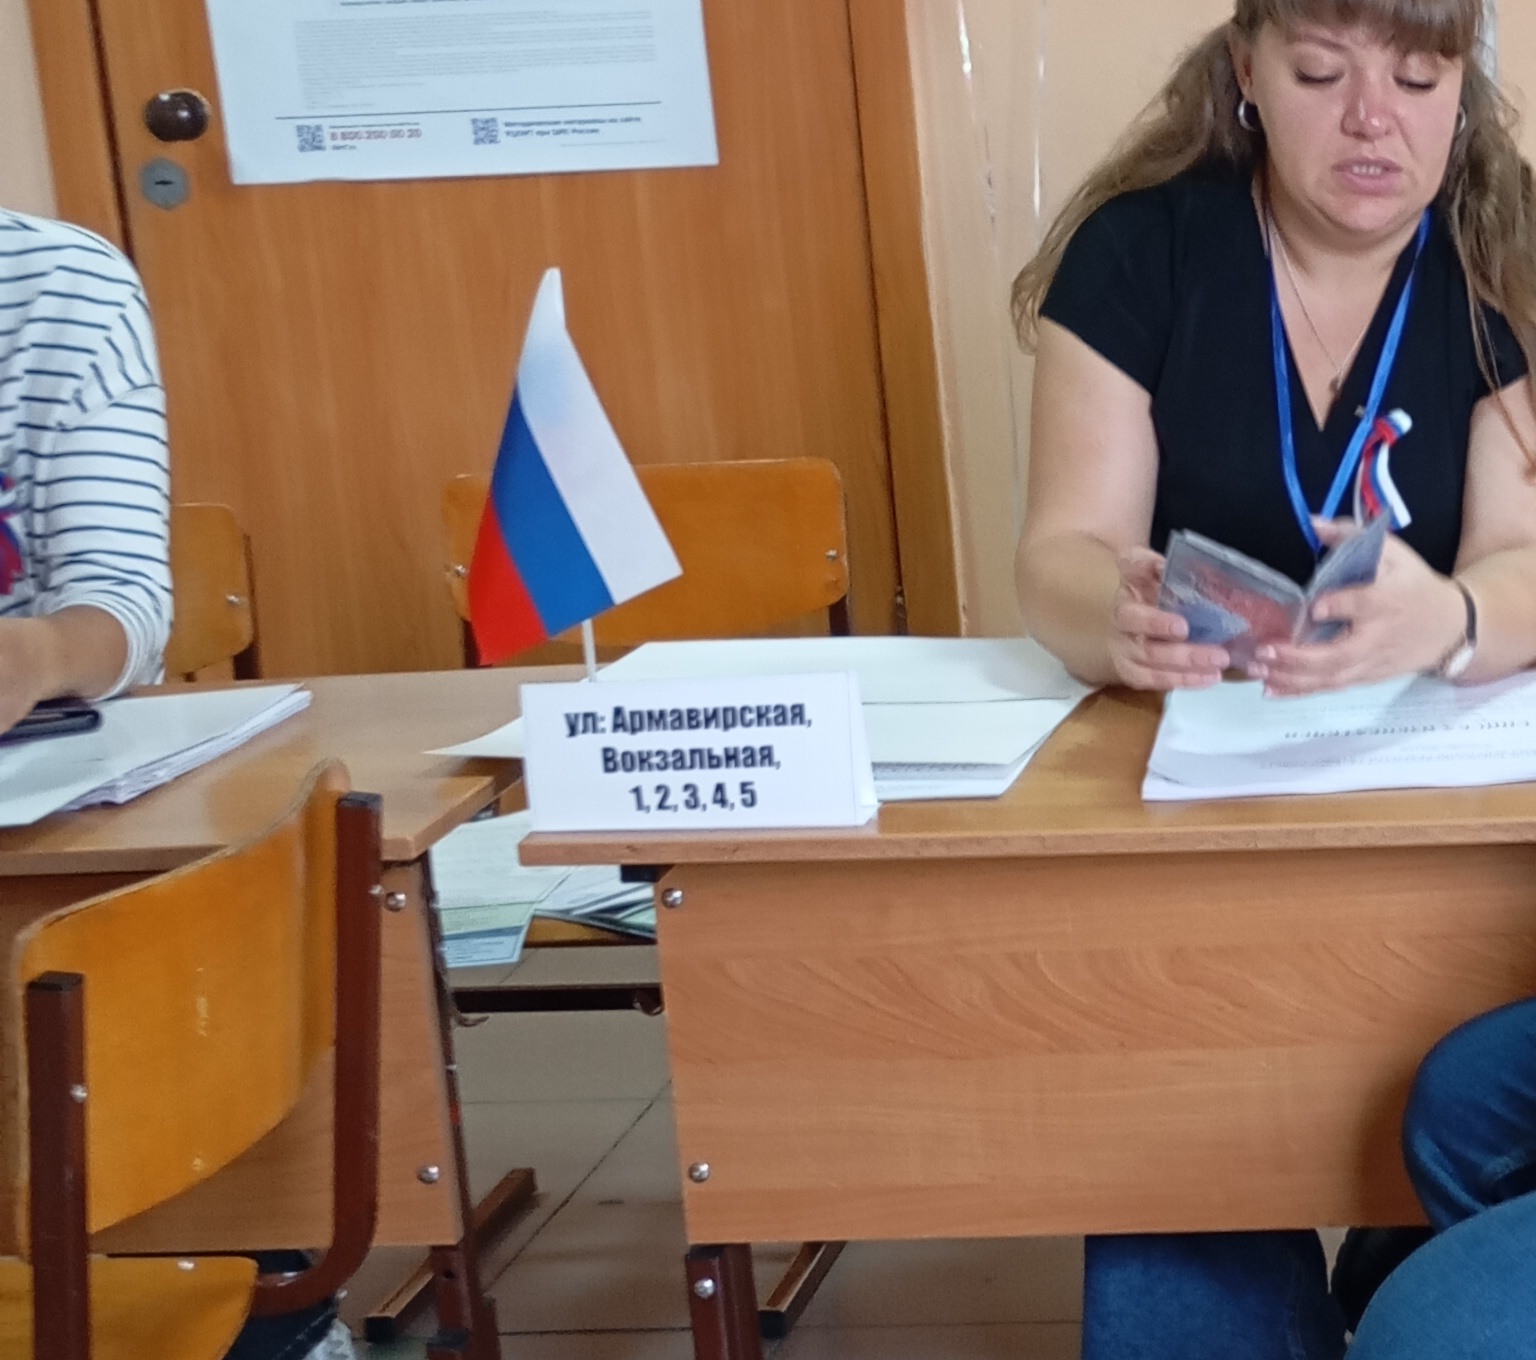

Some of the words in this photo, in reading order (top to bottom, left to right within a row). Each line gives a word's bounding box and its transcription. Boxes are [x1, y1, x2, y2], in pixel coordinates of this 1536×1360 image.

[564, 710, 605, 738] ул:
[612, 702, 813, 736] Армавирская,
[601, 744, 782, 774] Вокзальная,
[629, 784, 651, 813] 1,
[655, 783, 679, 812] 2,
[683, 782, 707, 812] 3,
[712, 781, 736, 811] 4,
[740, 781, 758, 808] 5
